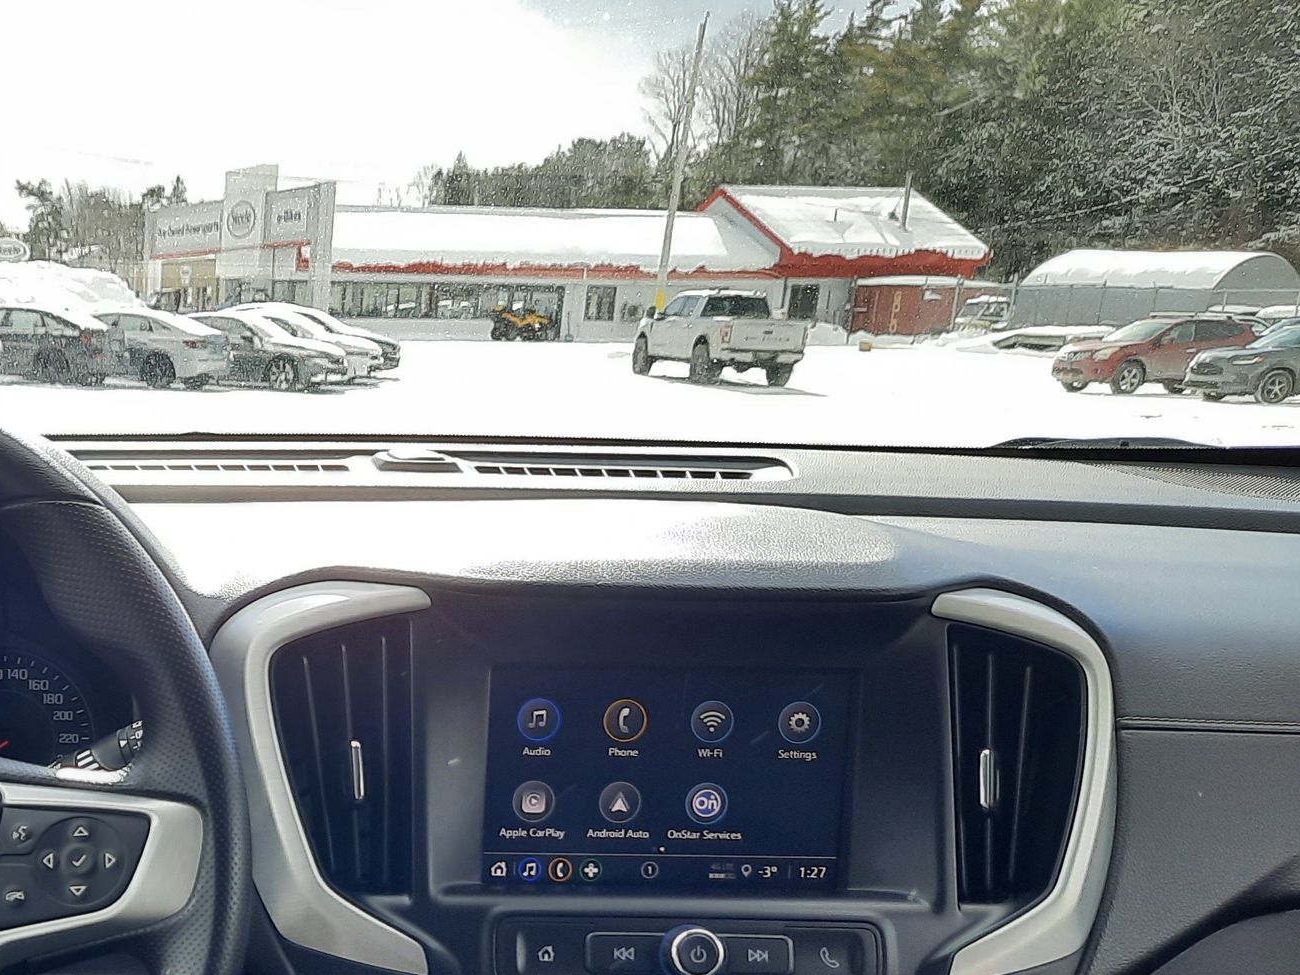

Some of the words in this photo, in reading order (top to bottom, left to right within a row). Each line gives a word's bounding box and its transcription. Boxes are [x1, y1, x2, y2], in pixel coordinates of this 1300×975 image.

[7, 668, 28, 680] 140
[28, 679, 49, 691] 160
[42, 693, 64, 705] 180
[53, 710, 73, 722] 200
[59, 733, 79, 745] 220
[521, 746, 551, 757] Audio
[608, 746, 639, 758] Phone
[777, 749, 817, 761] Settings
[695, 795, 718, 811] On
[499, 827, 528, 840] Apple
[529, 827, 565, 840] CarPlay
[586, 828, 625, 839] Android
[626, 829, 650, 839] Auto
[667, 829, 701, 840] OnStar
[702, 829, 742, 840] Services
[798, 866, 827, 879] 1:27
